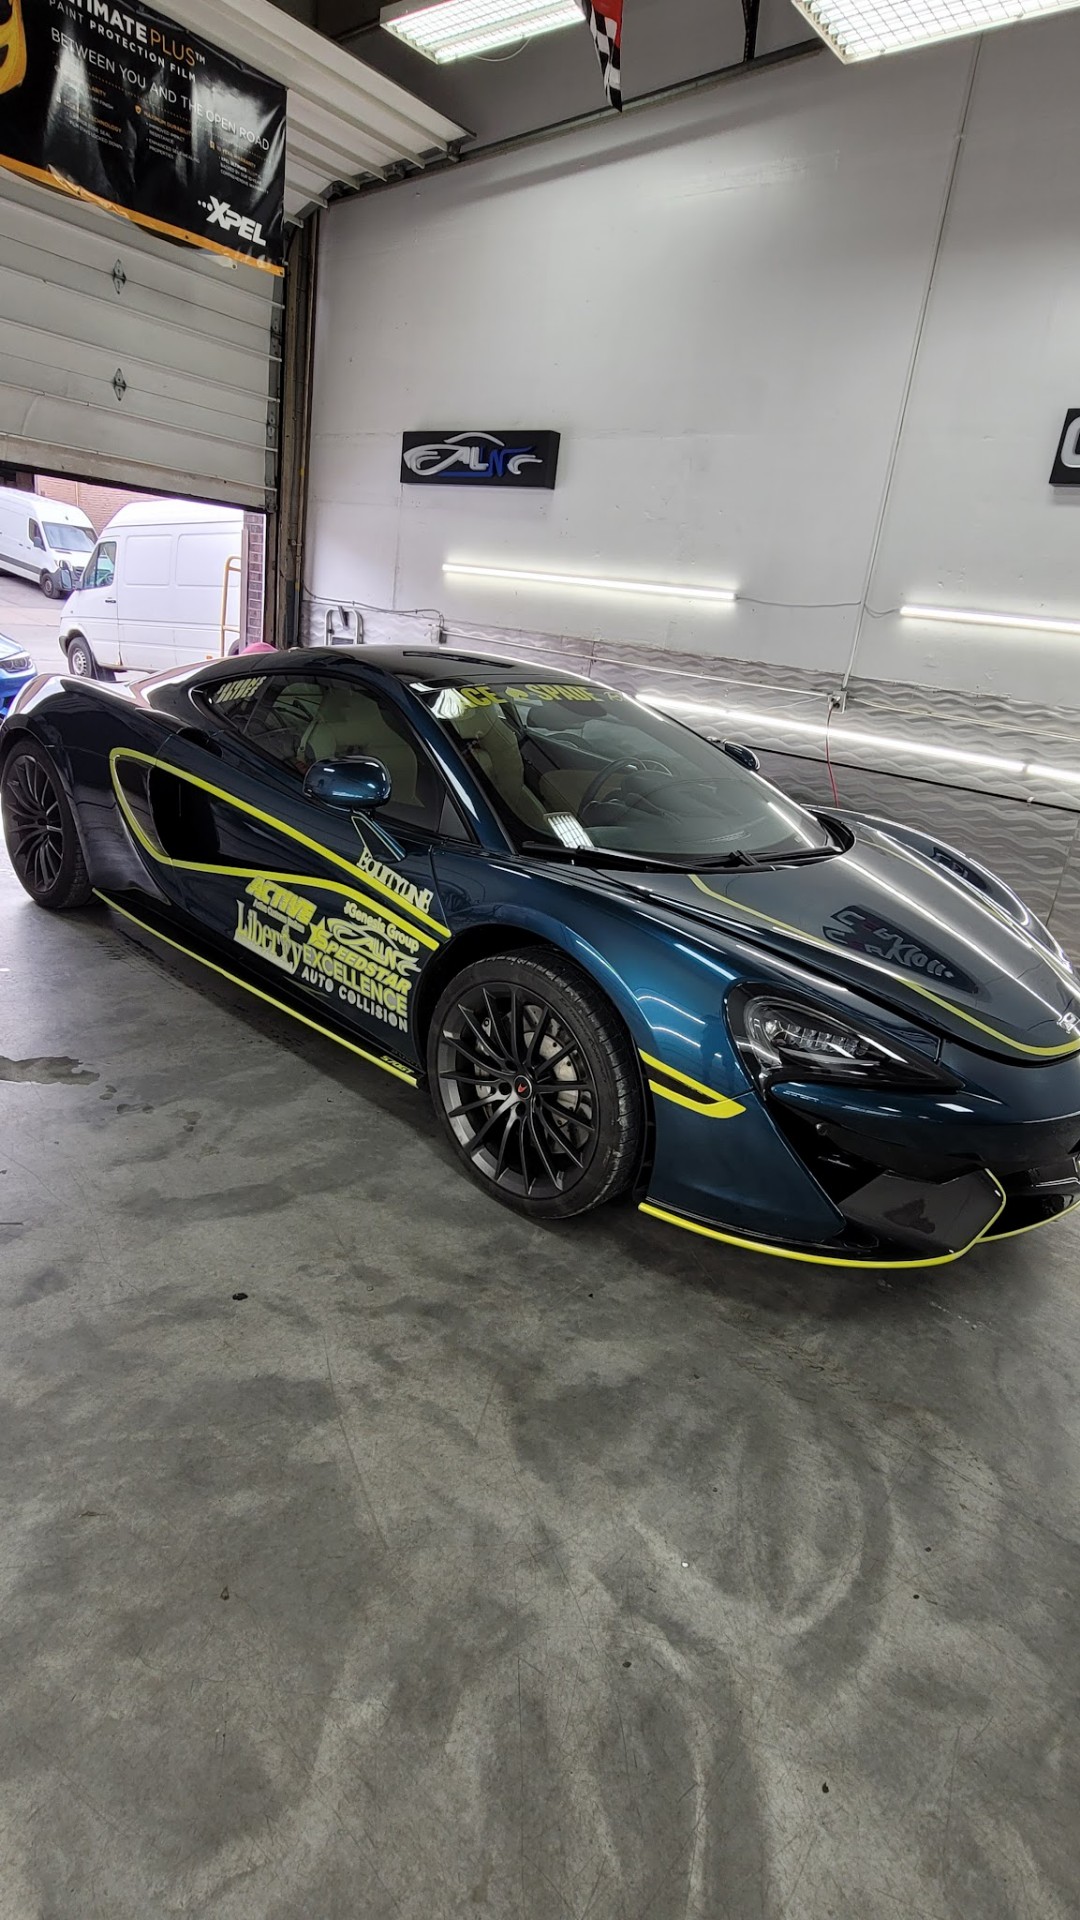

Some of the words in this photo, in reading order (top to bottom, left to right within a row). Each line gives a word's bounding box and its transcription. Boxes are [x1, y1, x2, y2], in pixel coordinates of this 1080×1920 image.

[90, 20, 166, 68] PROTECTION
[170, 62, 196, 83] FILM
[51, 27, 116, 74] BETWEEN
[119, 64, 146, 88] YOU
[150, 81, 177, 103] AND
[180, 95, 203, 117] THE
[206, 110, 236, 134] OPEN
[239, 126, 270, 151] ROAD
[206, 195, 267, 247] XPEL
[459, 686, 508, 711] ACE
[525, 683, 605, 702] SPADE
[245, 876, 318, 926] ACTIVE
[235, 899, 303, 975] Liberty
[311, 926, 413, 996] SPEEDSTAR
[386, 923, 420, 954] Group
[301, 965, 335, 993] AUTO
[338, 985, 408, 1034] COLLISION
[302, 942, 409, 1019] EXCELLENCE
